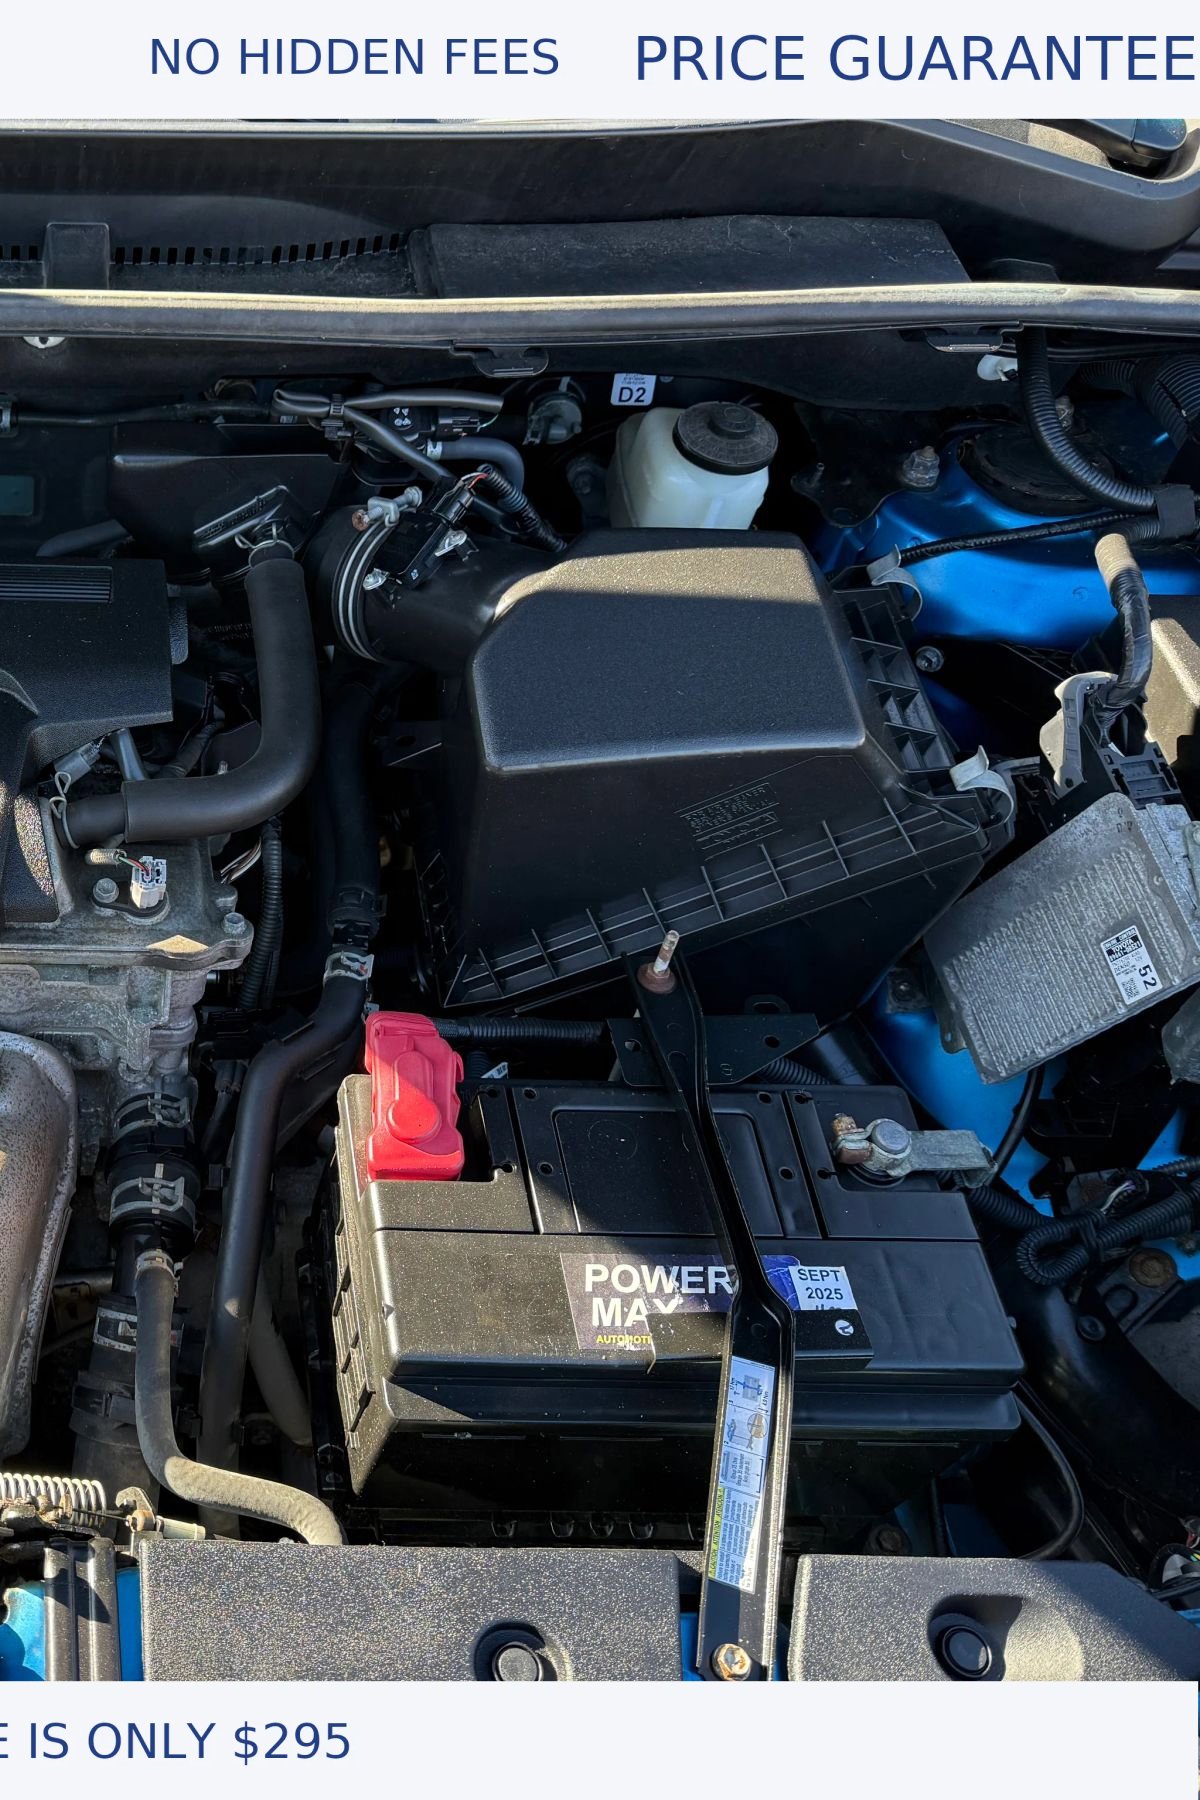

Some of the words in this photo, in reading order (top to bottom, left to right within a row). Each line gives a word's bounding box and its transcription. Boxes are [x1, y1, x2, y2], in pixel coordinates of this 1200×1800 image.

[618, 386, 647, 403] D2
[1112, 939, 1134, 954] TOYOTA
[1138, 964, 1158, 990] 52
[585, 1263, 733, 1295] POWER
[797, 1268, 841, 1282] SEPT
[805, 1287, 844, 1301] 2025
